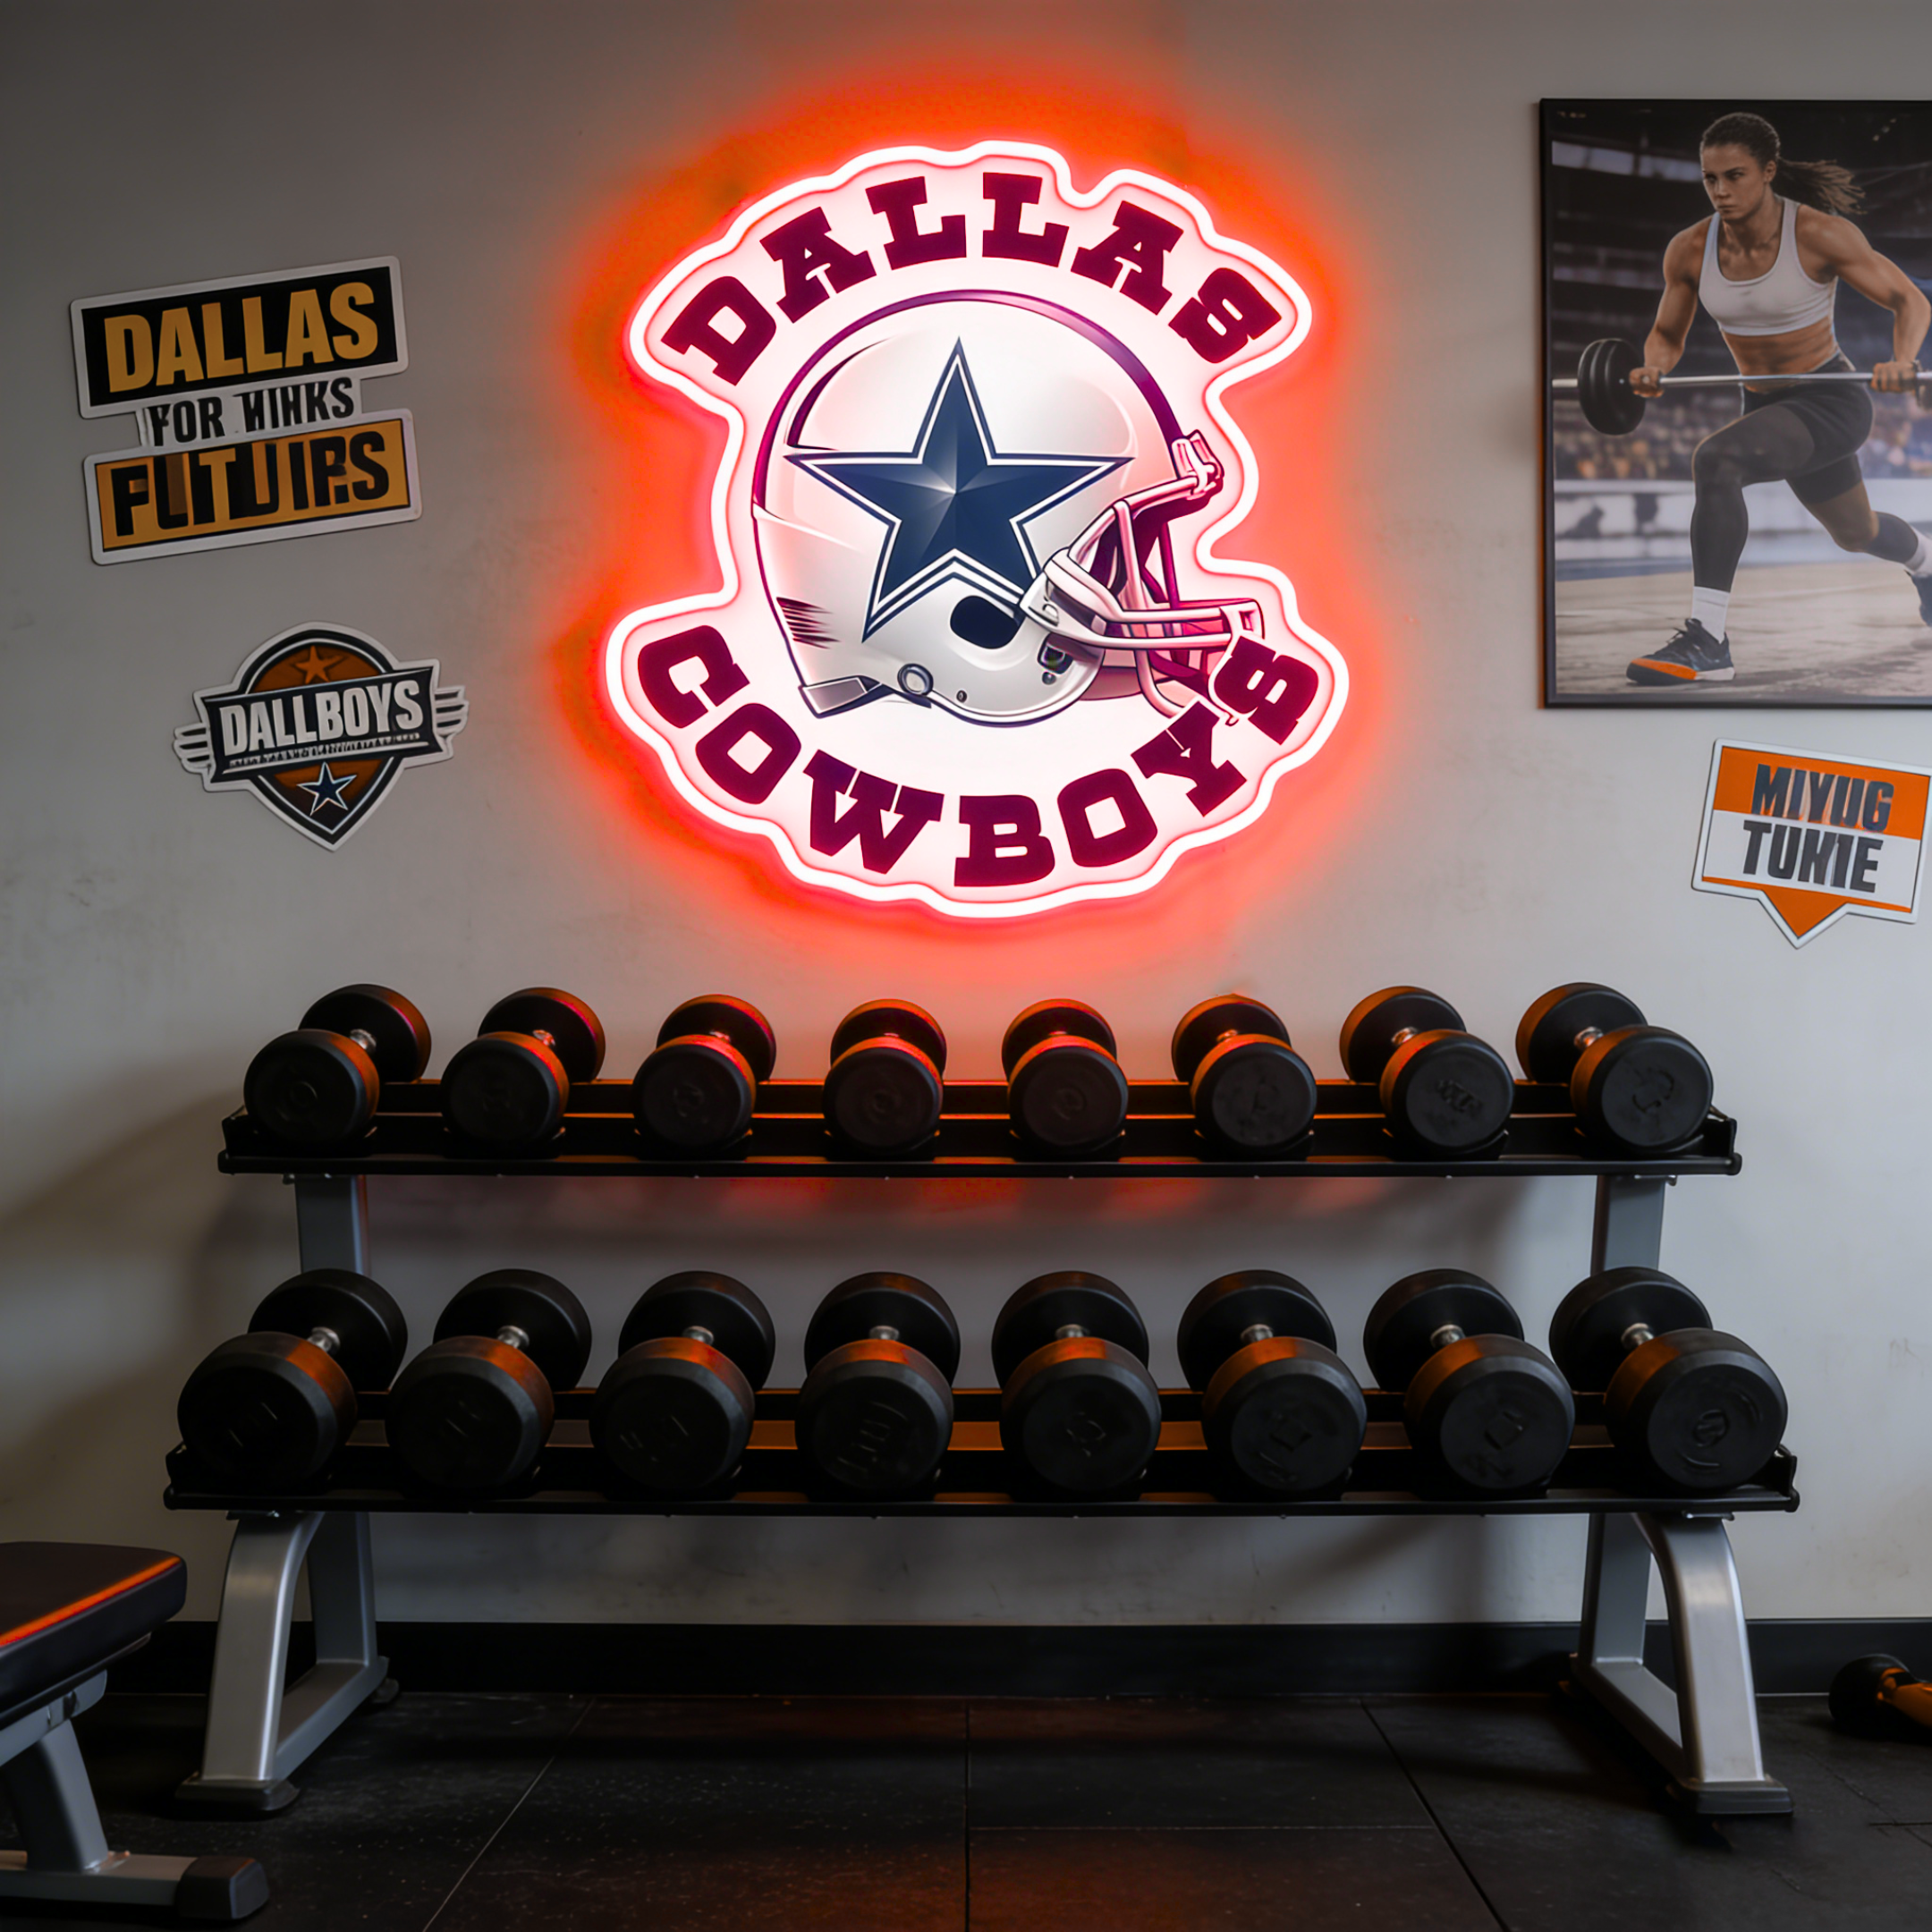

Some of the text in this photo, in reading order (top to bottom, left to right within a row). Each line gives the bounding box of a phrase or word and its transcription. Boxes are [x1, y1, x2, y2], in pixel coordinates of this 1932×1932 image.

[104, 282, 378, 393] DALLAS
[663, 171, 1282, 386] DALLAS
[219, 680, 424, 757] DALLBOYS
[638, 624, 1318, 887] COWBOYS
